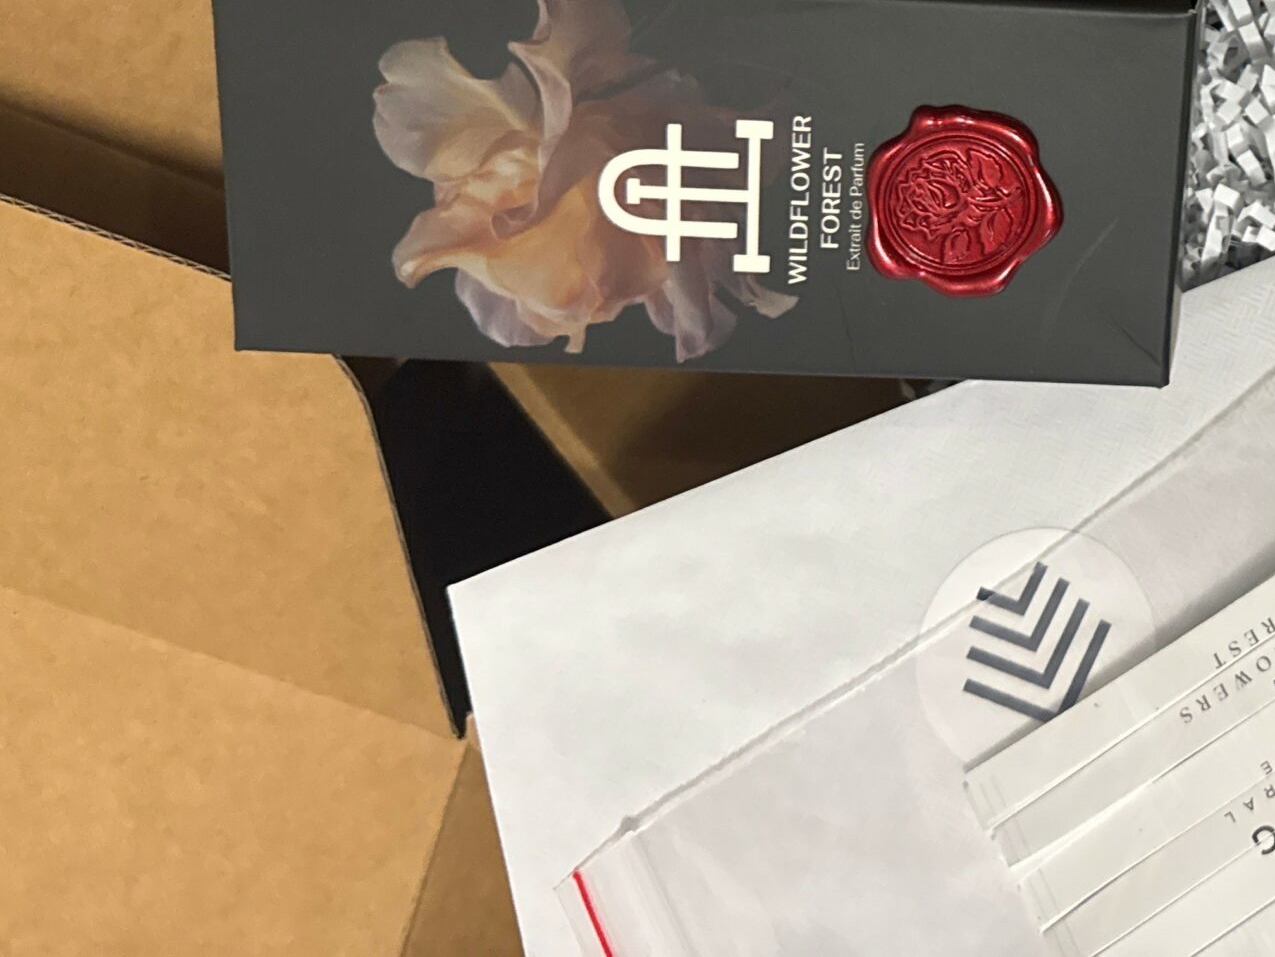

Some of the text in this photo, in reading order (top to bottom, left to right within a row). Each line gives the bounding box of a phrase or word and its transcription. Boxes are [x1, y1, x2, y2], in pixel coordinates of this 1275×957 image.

[787, 115, 813, 285] WILDFLOWER
[820, 146, 843, 249] FOREST
[846, 142, 865, 271] Extrait de Parfum
